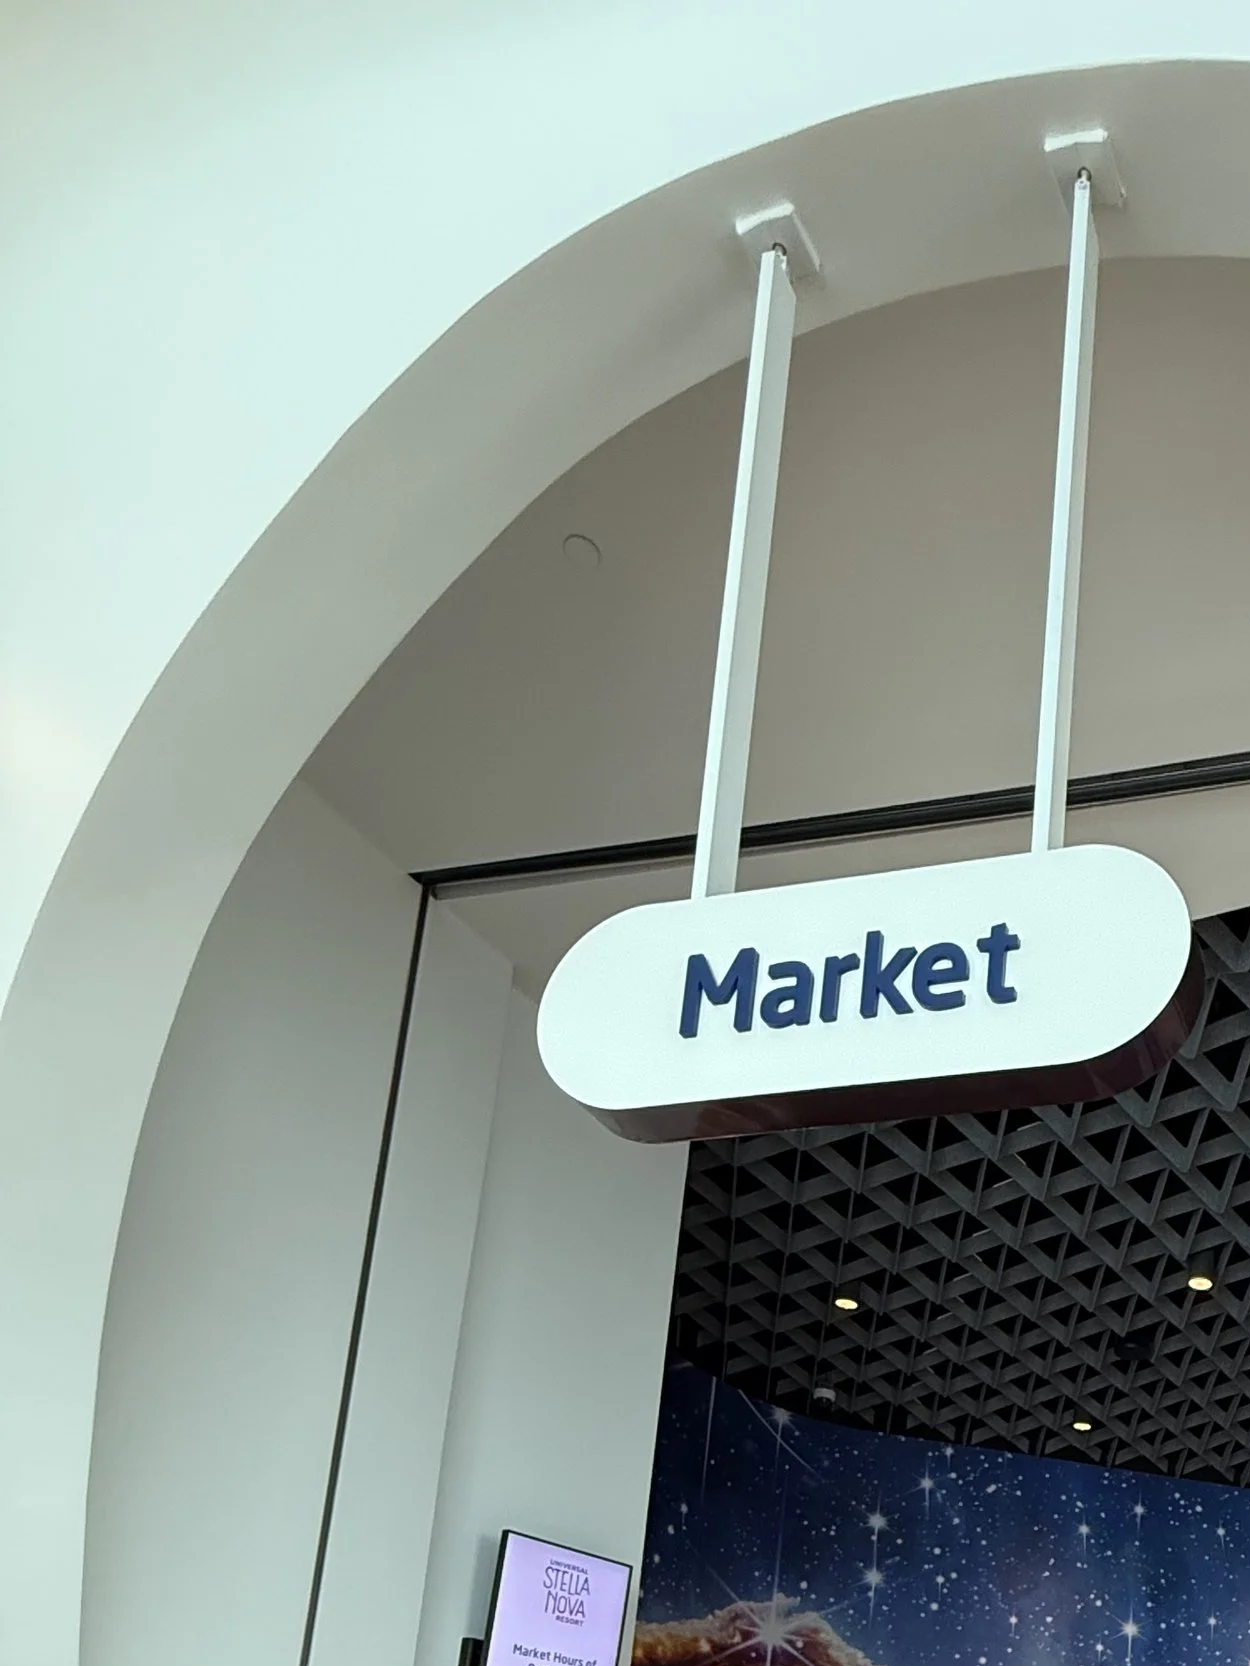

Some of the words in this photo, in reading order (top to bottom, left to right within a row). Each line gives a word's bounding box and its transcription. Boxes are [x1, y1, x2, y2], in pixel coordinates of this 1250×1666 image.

[679, 922, 1022, 1039] Market
[543, 1566, 590, 1596] STELLA
[545, 1590, 586, 1618] NOVA
[555, 1615, 584, 1627] RESORT
[513, 1644, 551, 1661] Market
